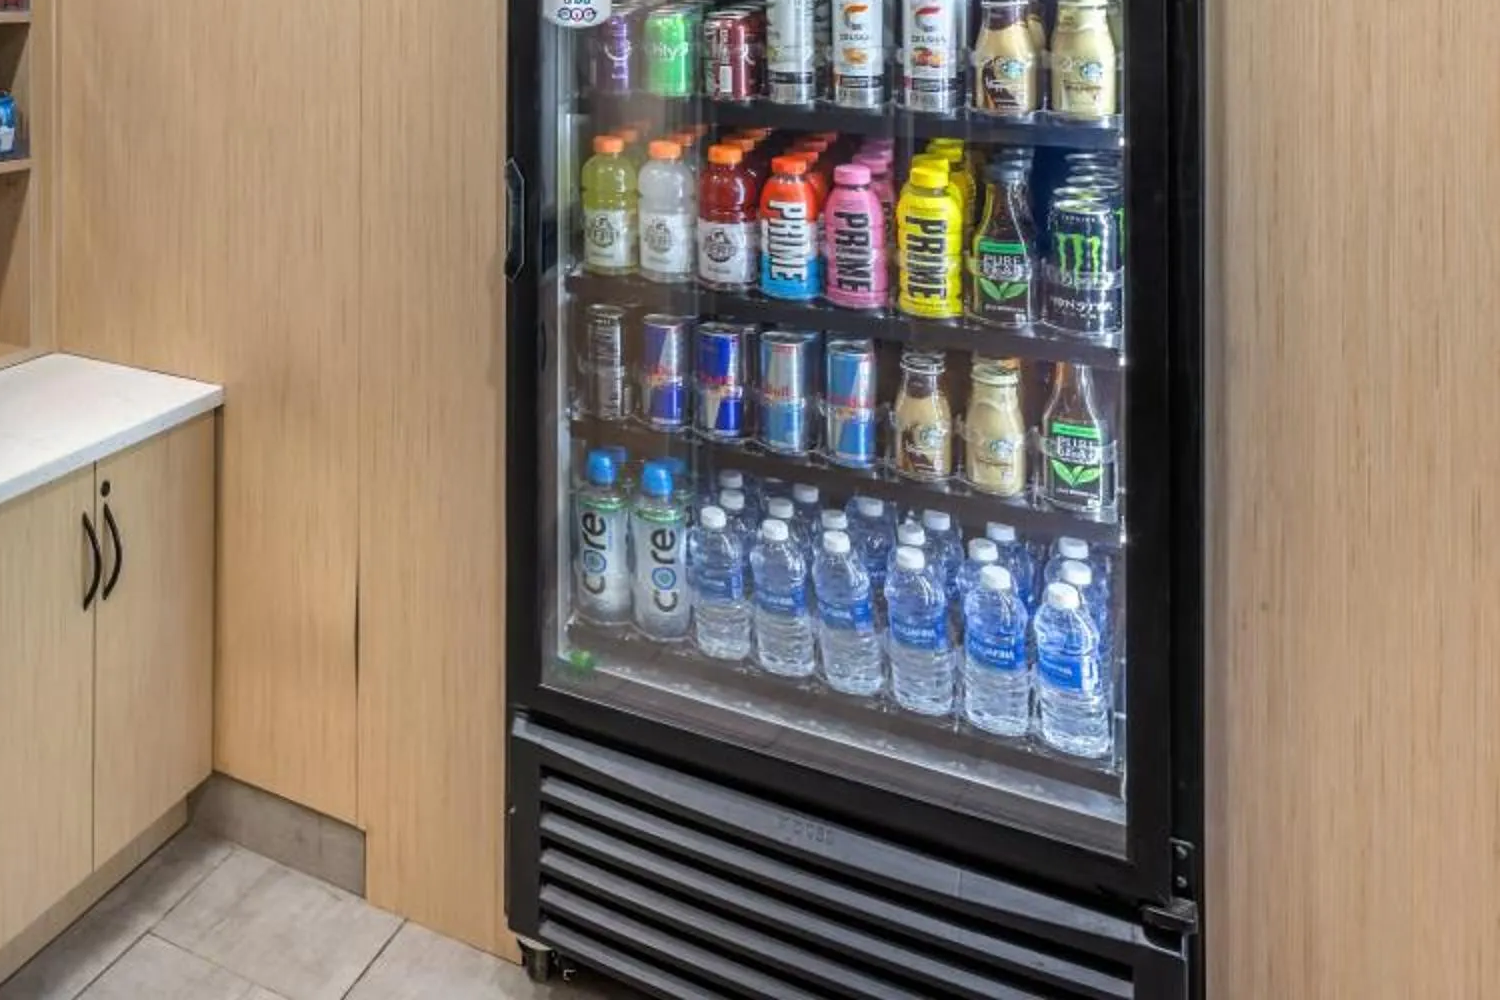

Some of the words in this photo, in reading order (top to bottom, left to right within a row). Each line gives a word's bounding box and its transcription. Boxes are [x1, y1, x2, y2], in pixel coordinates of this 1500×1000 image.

[768, 200, 808, 281] PRIME
[834, 211, 872, 292] PRIME
[905, 215, 948, 298] PRIME
[983, 255, 1021, 267] PURE
[581, 511, 607, 595] core
[650, 528, 678, 612] core
